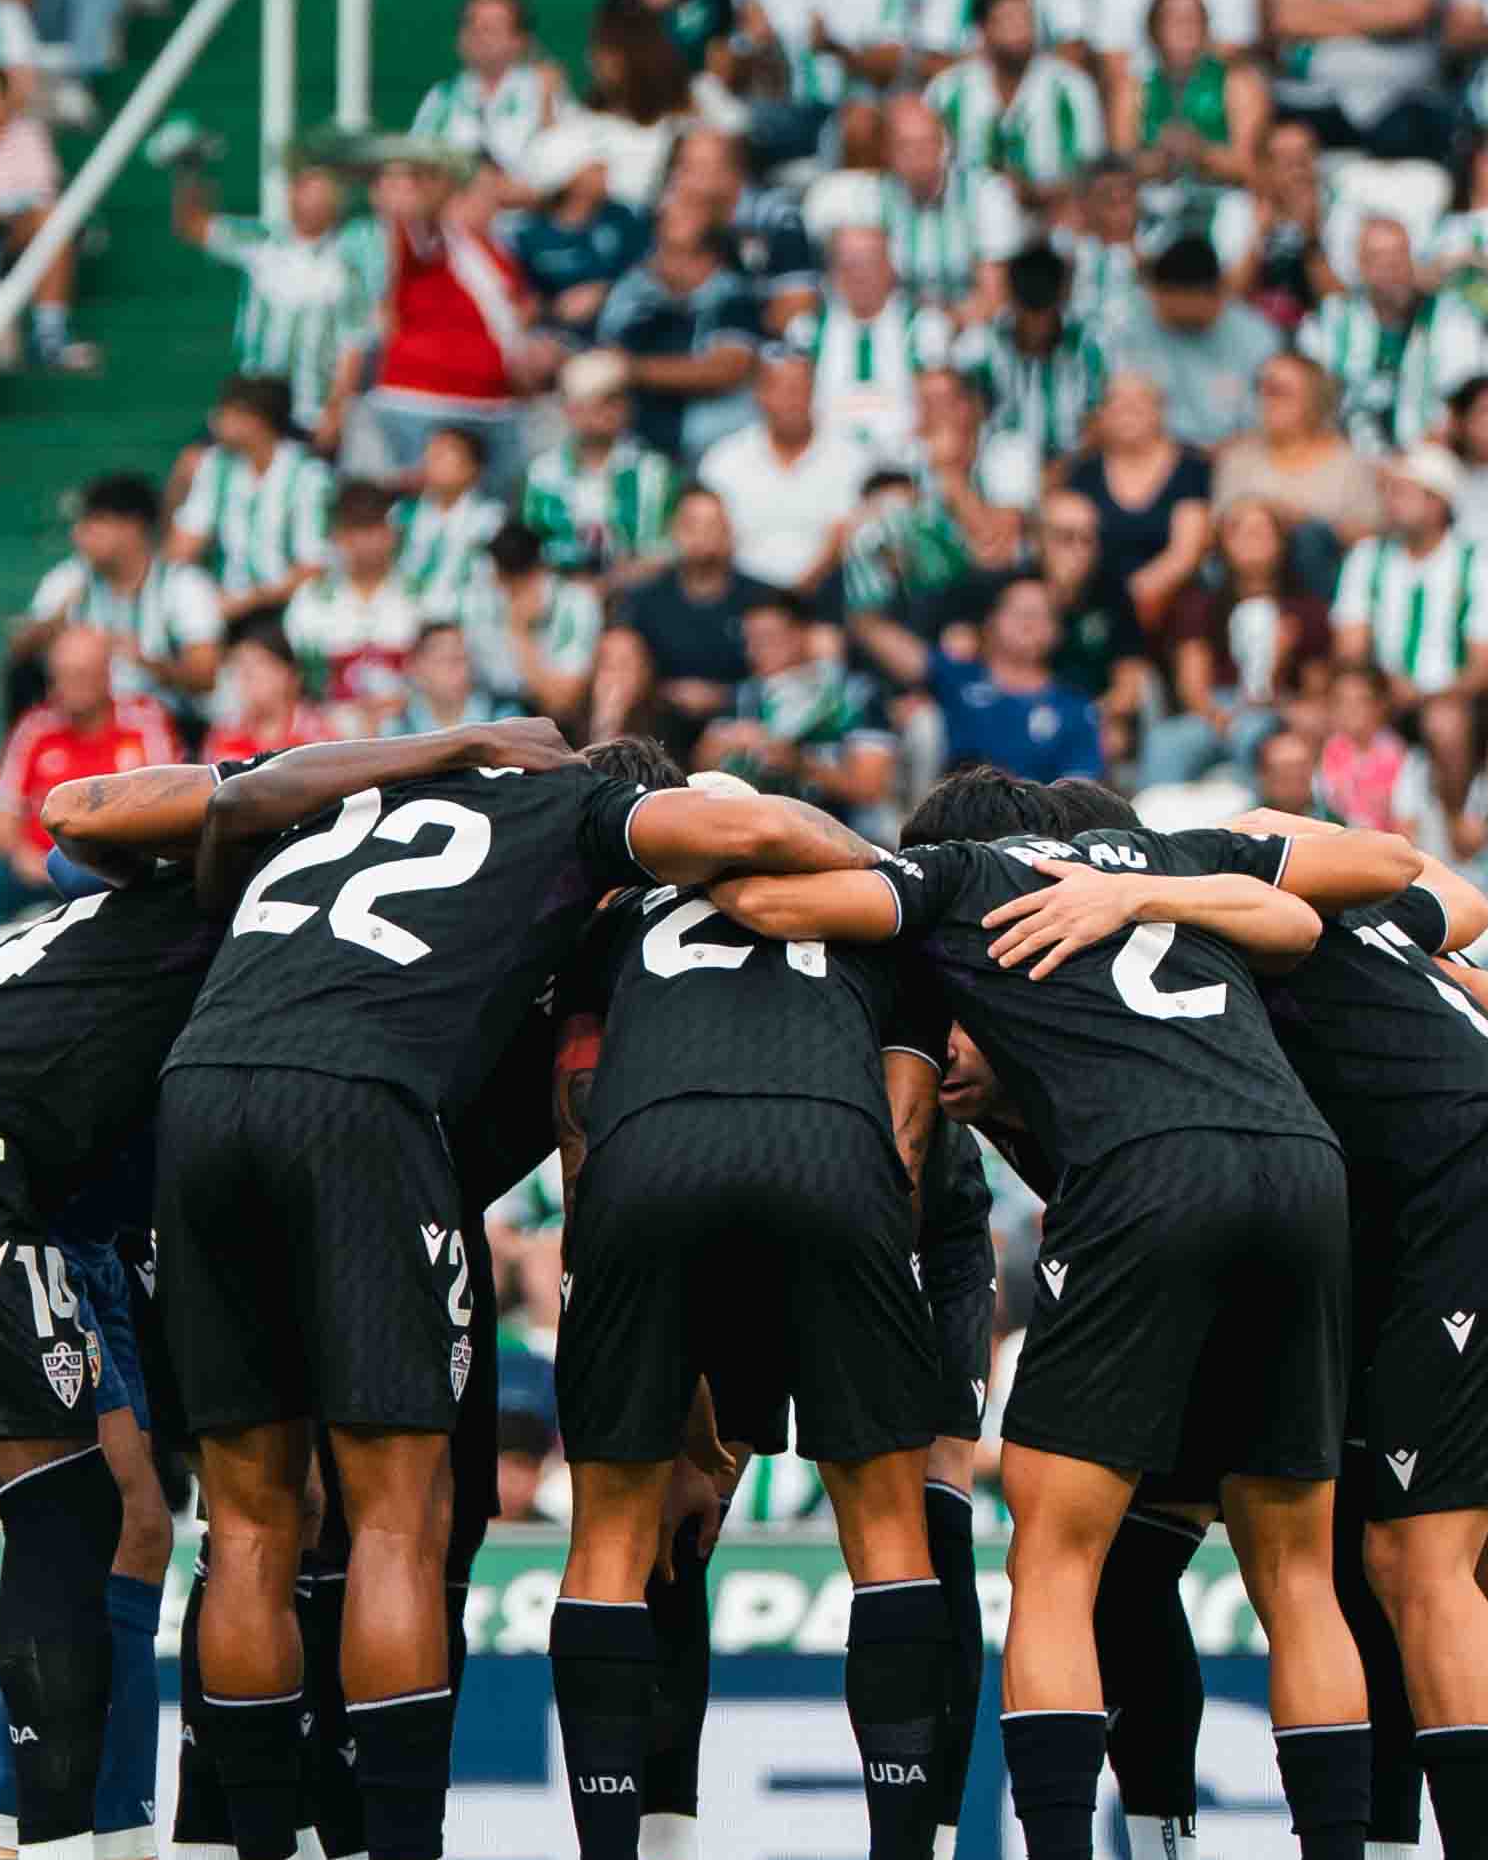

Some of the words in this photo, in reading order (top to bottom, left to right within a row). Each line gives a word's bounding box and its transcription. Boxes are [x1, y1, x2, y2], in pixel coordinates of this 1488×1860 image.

[232, 787, 491, 966] 22
[8, 1724, 39, 1745] DA
[578, 1775, 637, 1794] UDA
[869, 1762, 927, 1785] UDA
